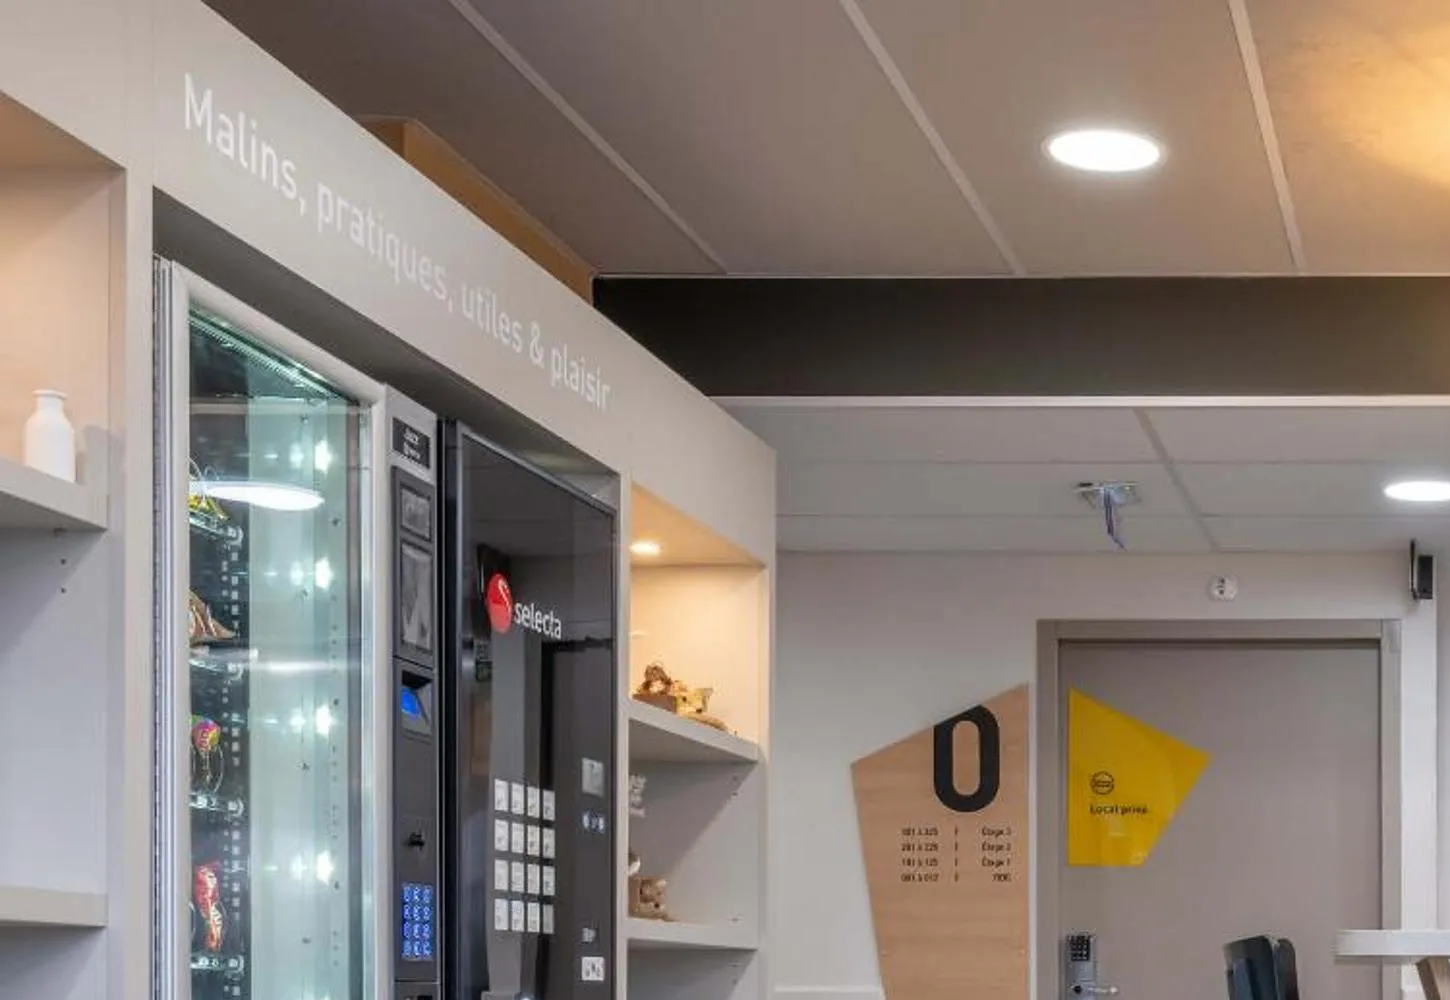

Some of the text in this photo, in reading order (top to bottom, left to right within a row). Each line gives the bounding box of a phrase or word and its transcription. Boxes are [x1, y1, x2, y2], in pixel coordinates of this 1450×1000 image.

[184, 72, 612, 413] Malins, pratiques, utiles & plaisir
[514, 602, 562, 640] selecta
[933, 704, 1000, 812] 0
[1090, 803, 1119, 814] Local
